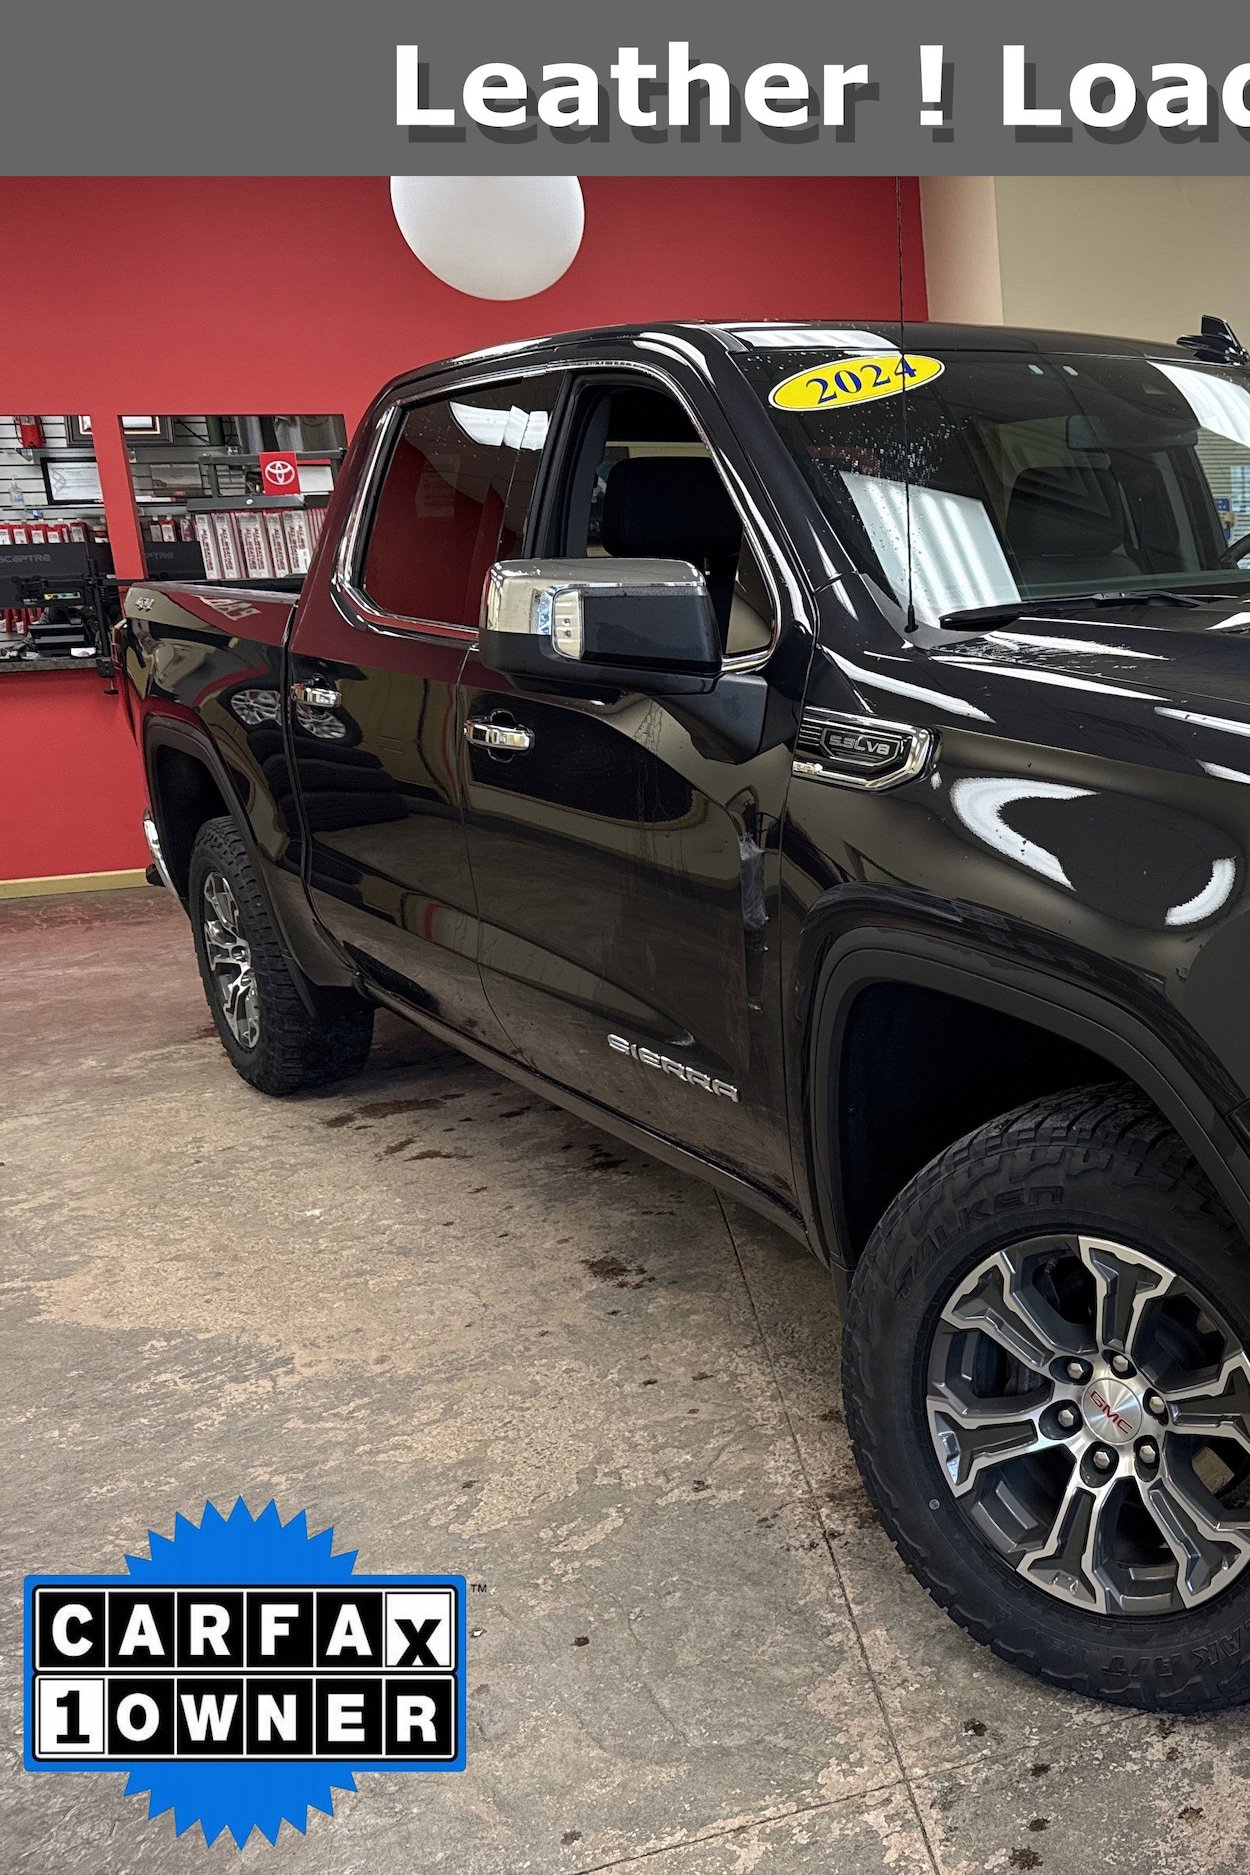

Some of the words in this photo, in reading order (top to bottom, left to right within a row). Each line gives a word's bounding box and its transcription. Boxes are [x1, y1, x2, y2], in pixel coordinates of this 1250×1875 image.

[806, 358, 917, 404] 2024
[867, 741, 891, 755] V8
[608, 1034, 739, 1103] SIERRA
[1091, 1391, 1133, 1434] GMC
